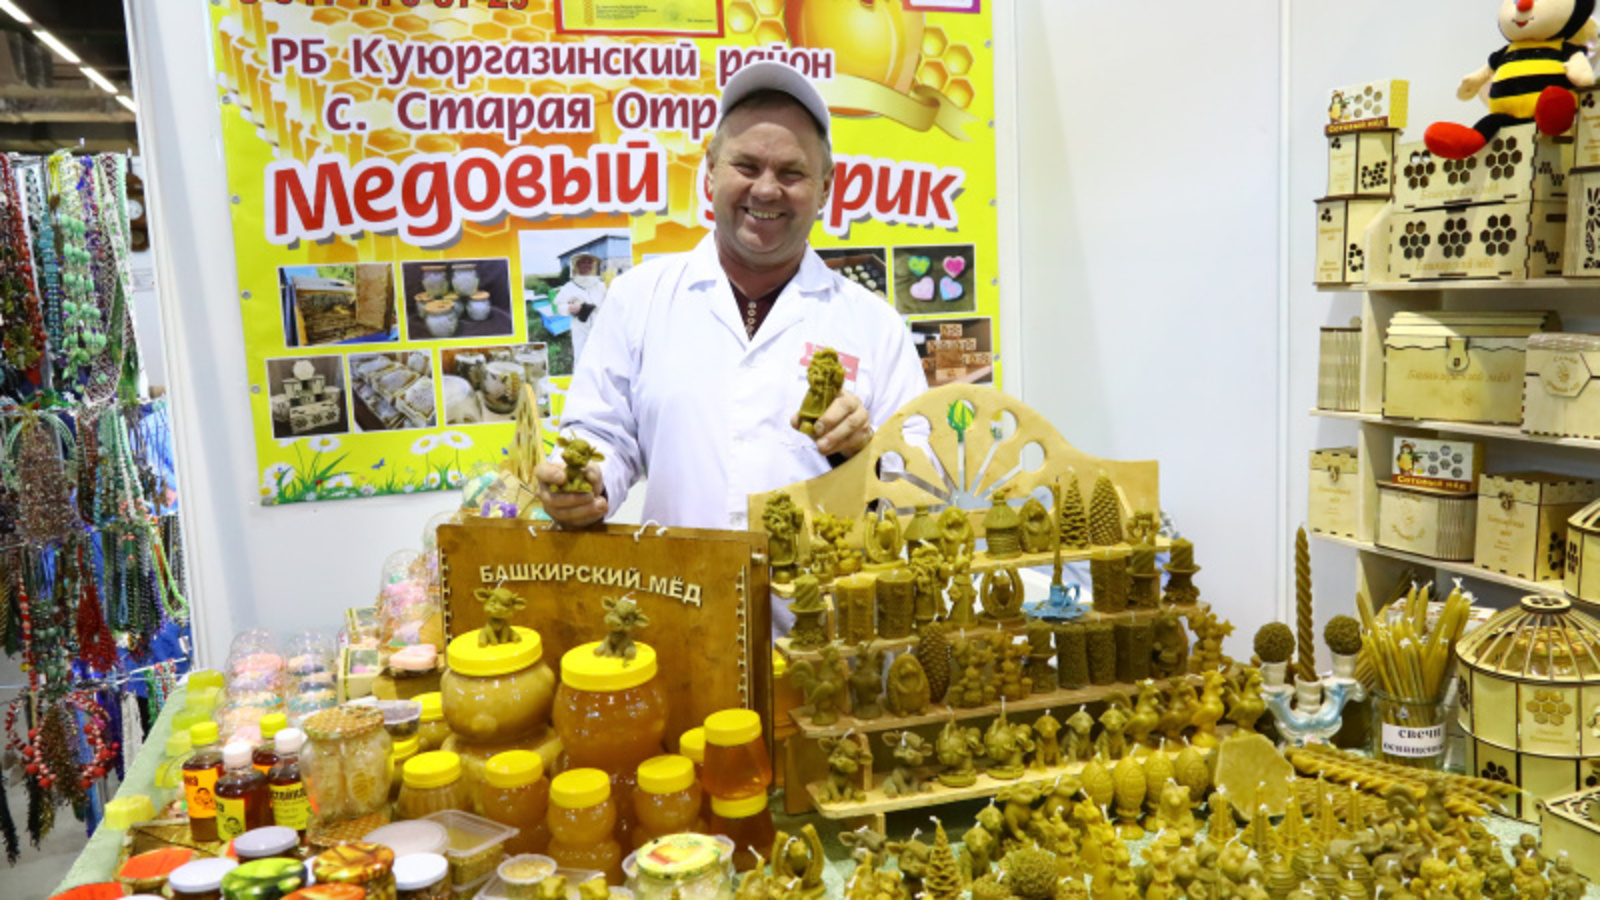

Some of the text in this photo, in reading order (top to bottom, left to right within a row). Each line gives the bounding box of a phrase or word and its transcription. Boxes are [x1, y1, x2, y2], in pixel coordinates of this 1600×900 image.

[271, 38, 327, 74] РБ
[353, 37, 697, 85] Куюргазинский
[326, 90, 717, 141] с. Старая Отр
[273, 141, 660, 237] Медовый
[479, 563, 703, 607] БАШКИРСКИЙ МЁД
